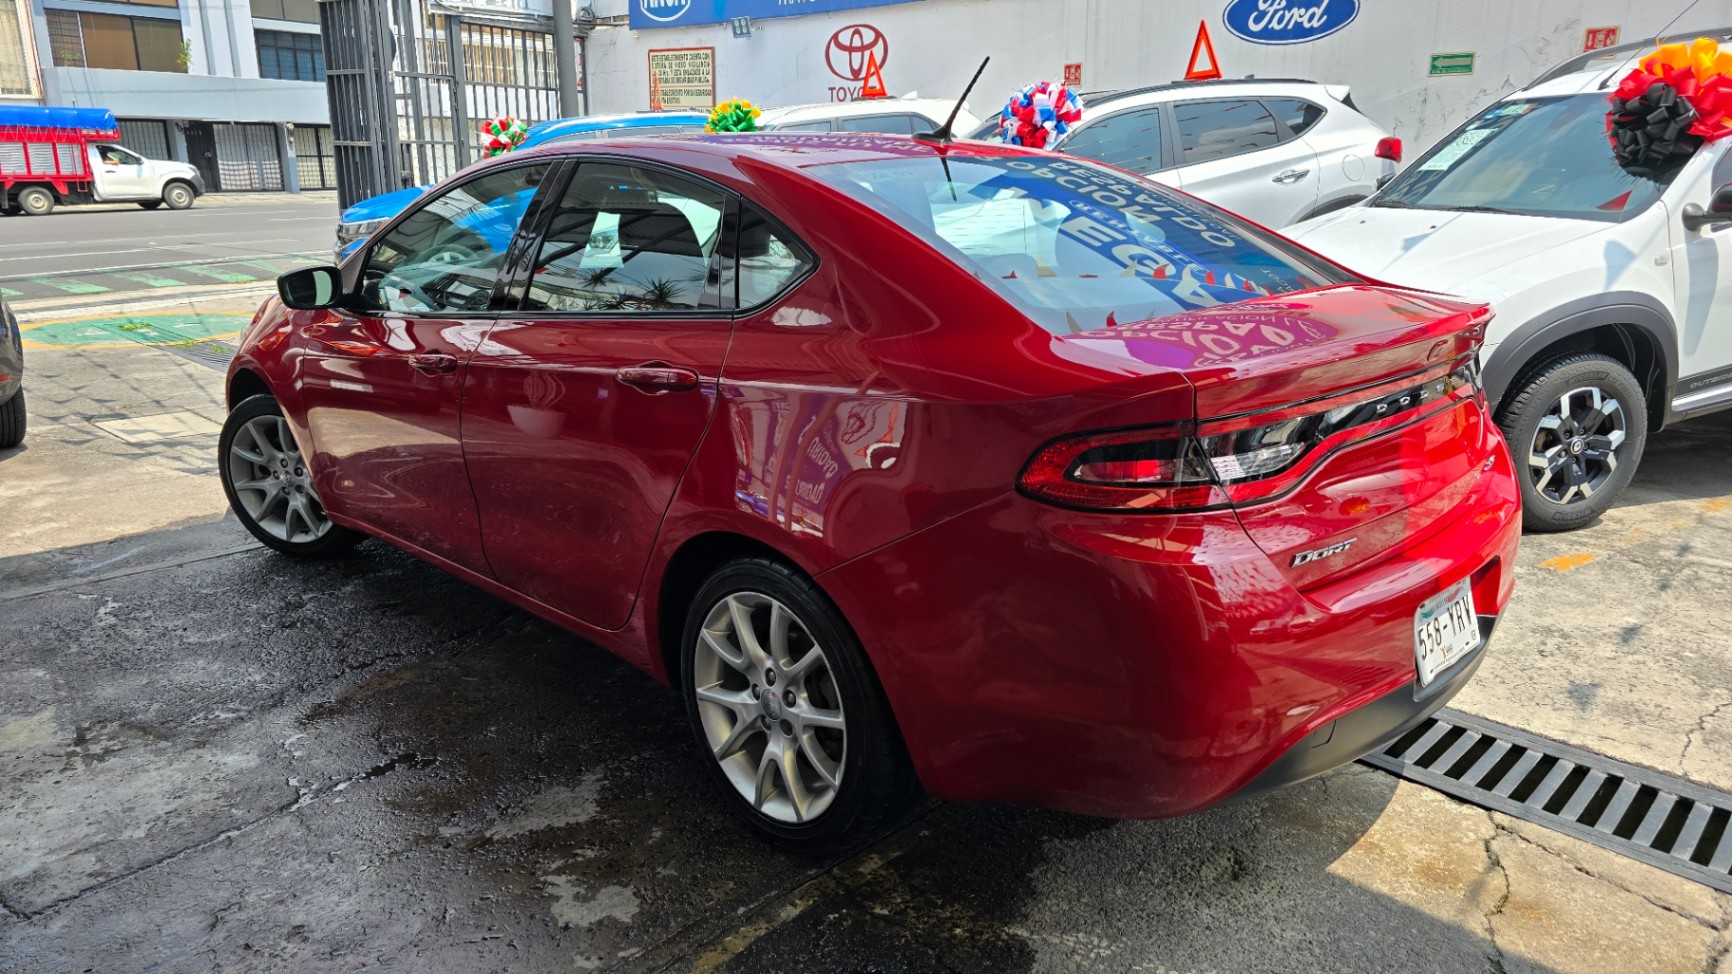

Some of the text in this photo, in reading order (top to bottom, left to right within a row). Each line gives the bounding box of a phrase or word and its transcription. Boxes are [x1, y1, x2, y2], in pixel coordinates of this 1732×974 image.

[1248, 0, 1329, 32] Ford
[828, 86, 877, 103] TOY
[1417, 594, 1472, 661] 558-YRV
